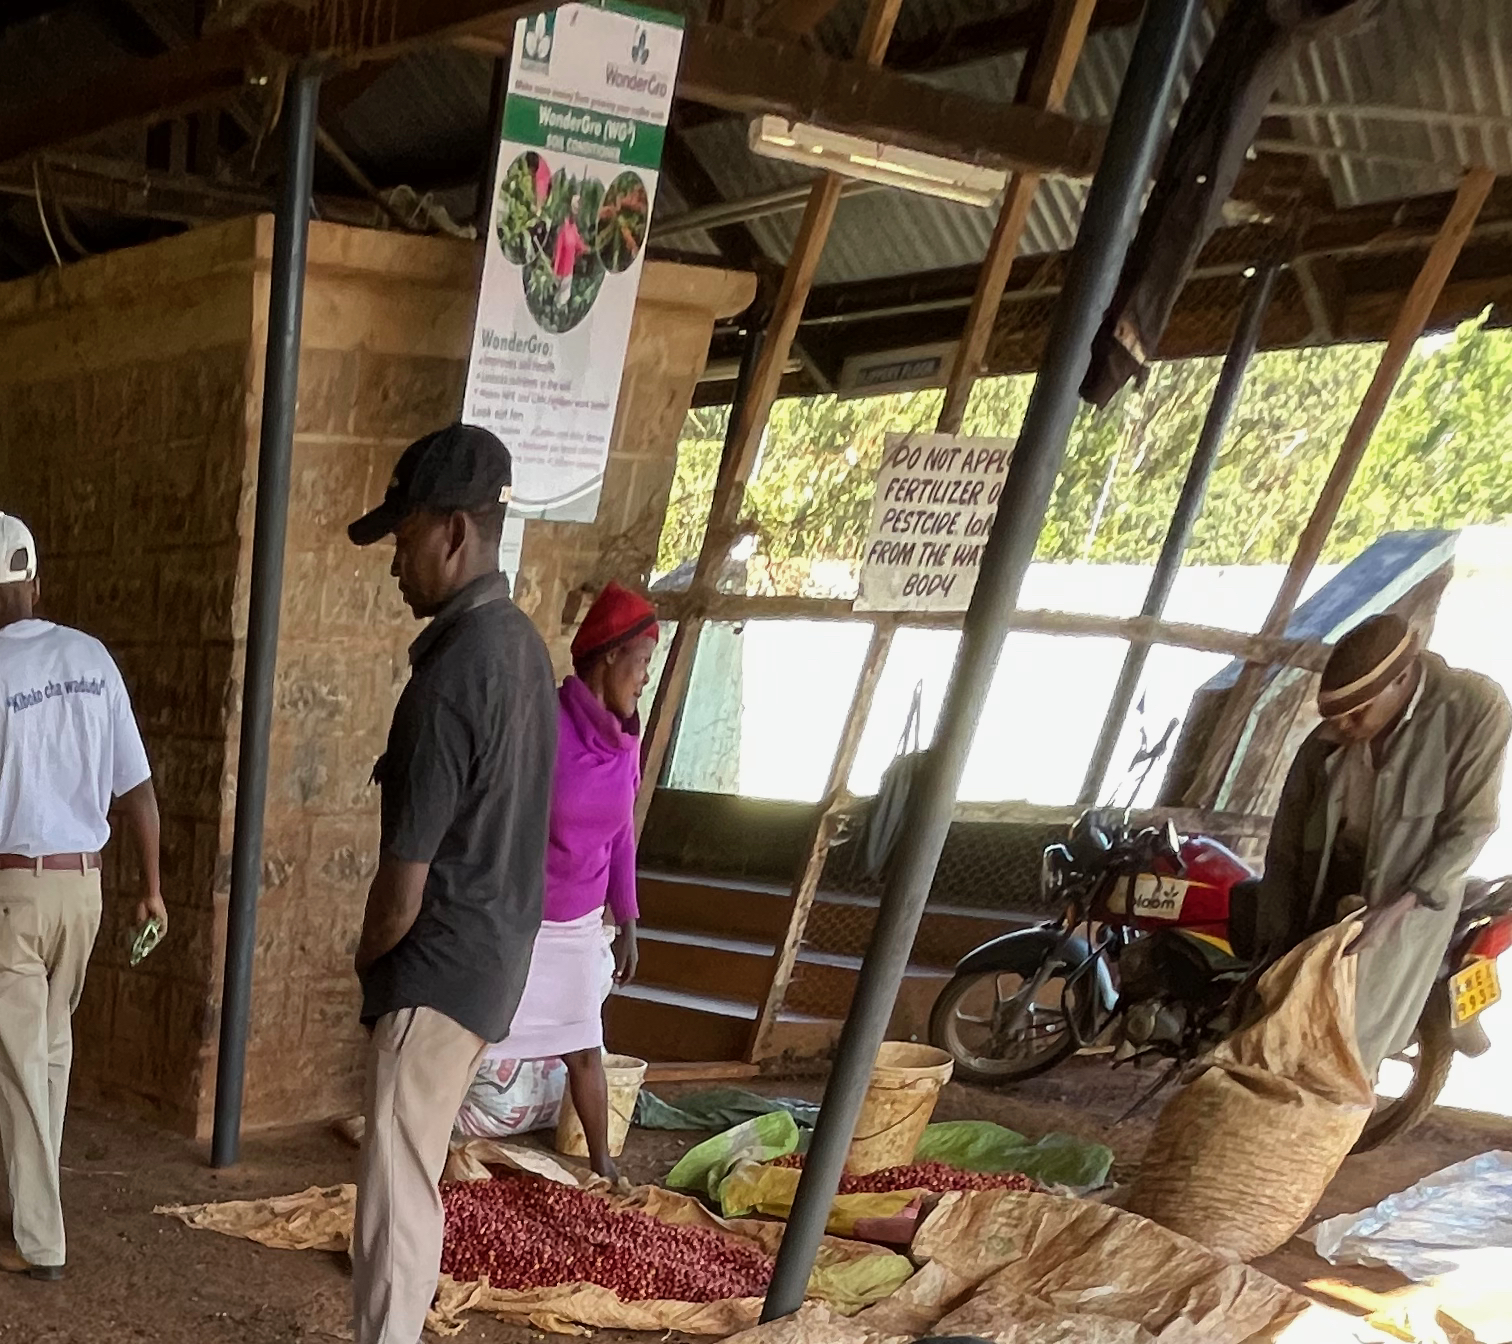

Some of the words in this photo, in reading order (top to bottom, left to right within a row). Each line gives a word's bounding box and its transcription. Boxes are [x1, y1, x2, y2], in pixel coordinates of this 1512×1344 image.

[606, 63, 668, 97] WonderGro
[539, 105, 602, 137] WonderGro
[892, 445, 922, 471] DO
[923, 447, 961, 473] NOT
[884, 477, 985, 506] FERTILIZER
[867, 540, 916, 567] FROM
[916, 542, 951, 567] THE
[902, 573, 958, 598] BODY
[1133, 894, 1175, 909] loom
